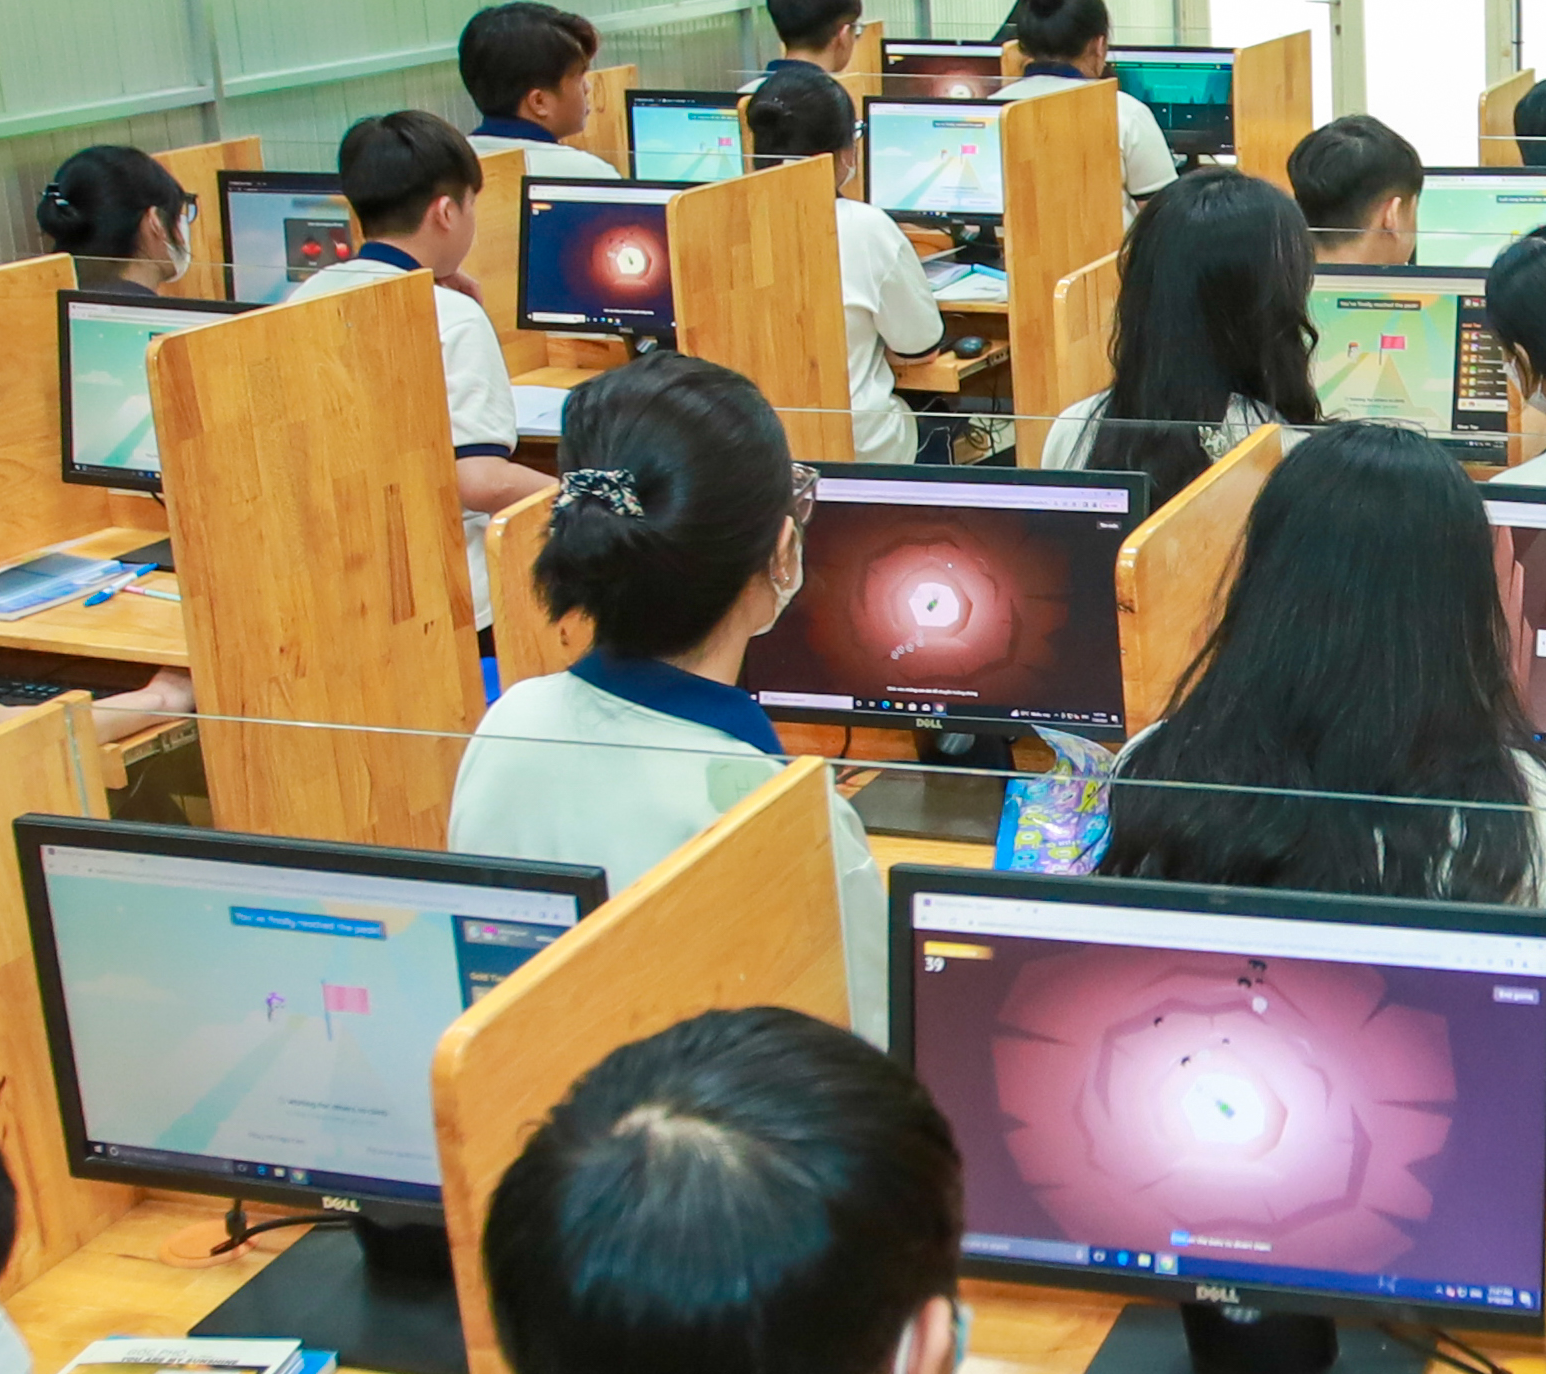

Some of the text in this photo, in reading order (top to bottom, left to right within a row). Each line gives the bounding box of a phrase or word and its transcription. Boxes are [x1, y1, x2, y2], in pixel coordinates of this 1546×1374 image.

[916, 718, 943, 730] DELL
[924, 957, 946, 973] 39
[321, 1196, 361, 1213] DELL
[1195, 1285, 1241, 1304] DELL
